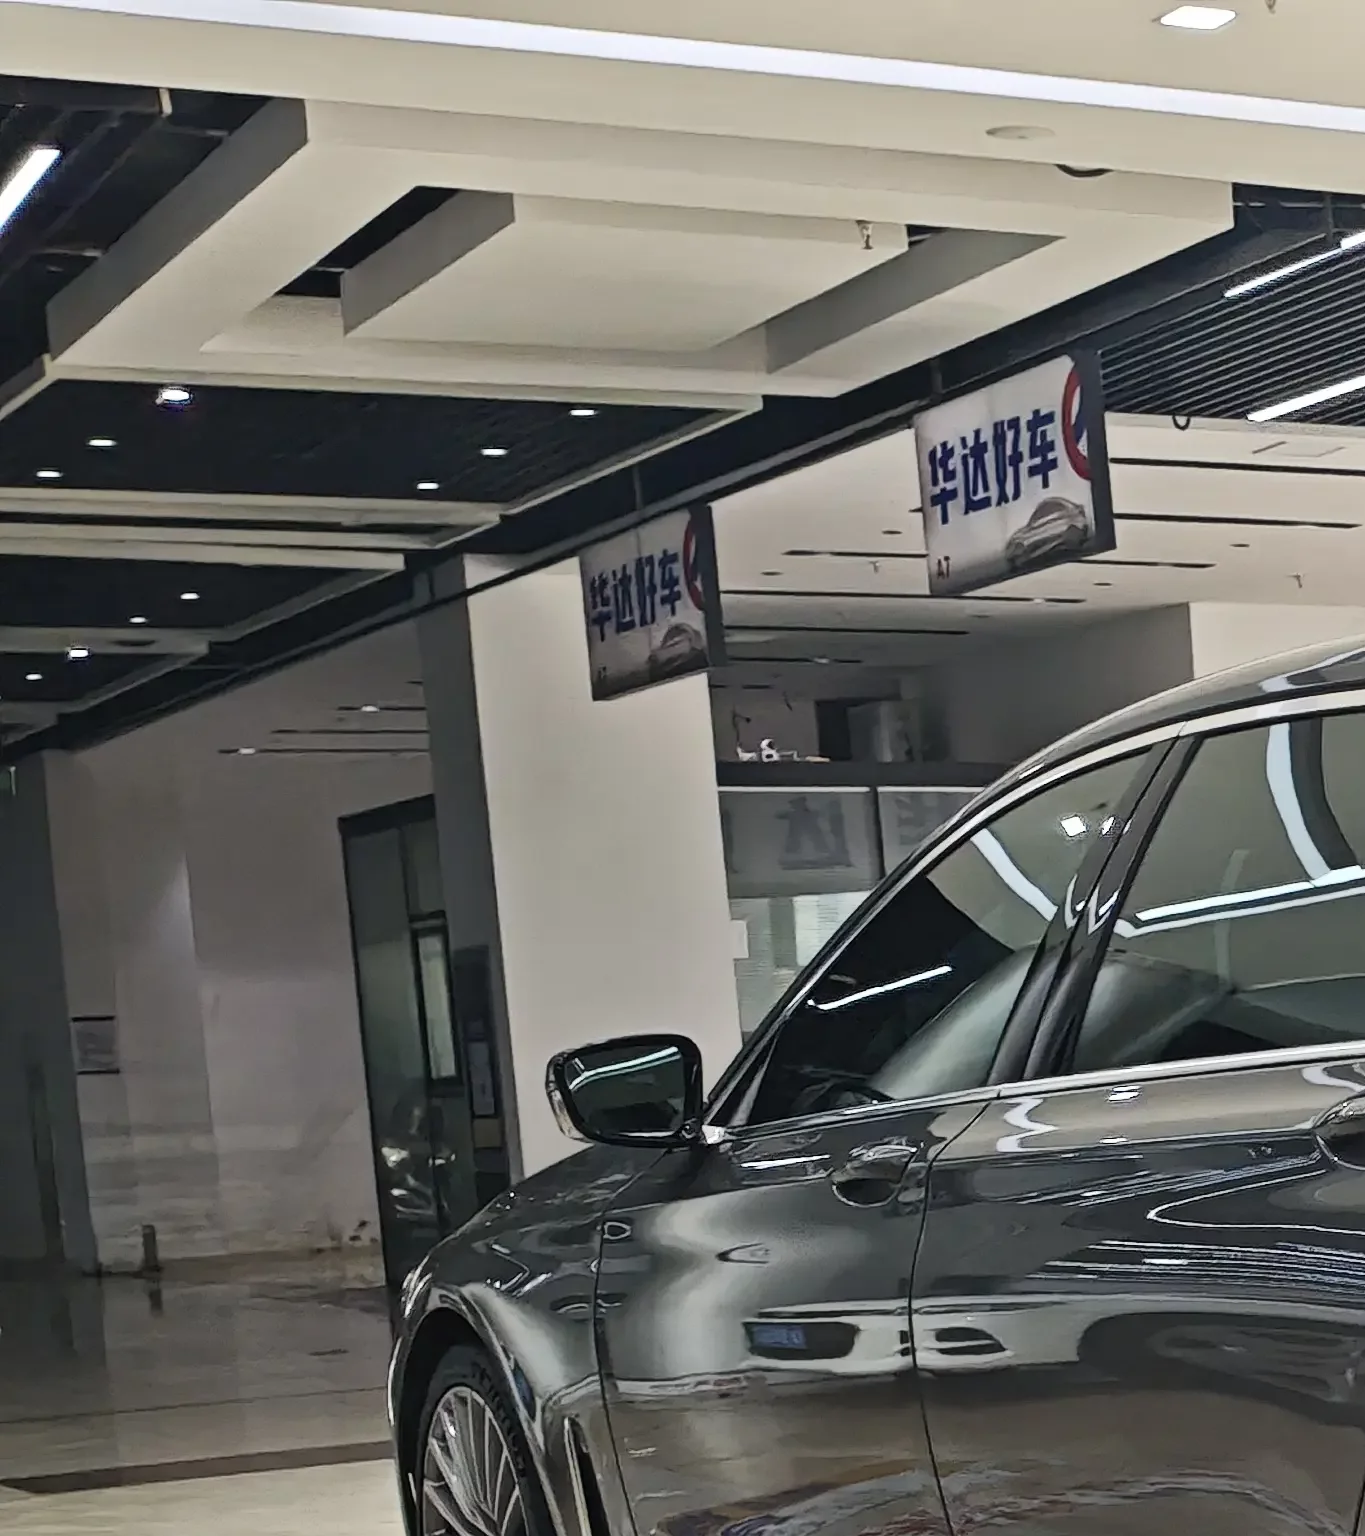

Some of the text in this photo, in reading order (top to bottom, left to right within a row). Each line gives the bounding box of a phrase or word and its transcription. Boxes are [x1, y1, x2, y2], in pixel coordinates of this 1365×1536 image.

[928, 409, 1058, 525] 华达好车
[589, 548, 682, 643] 华达好车
